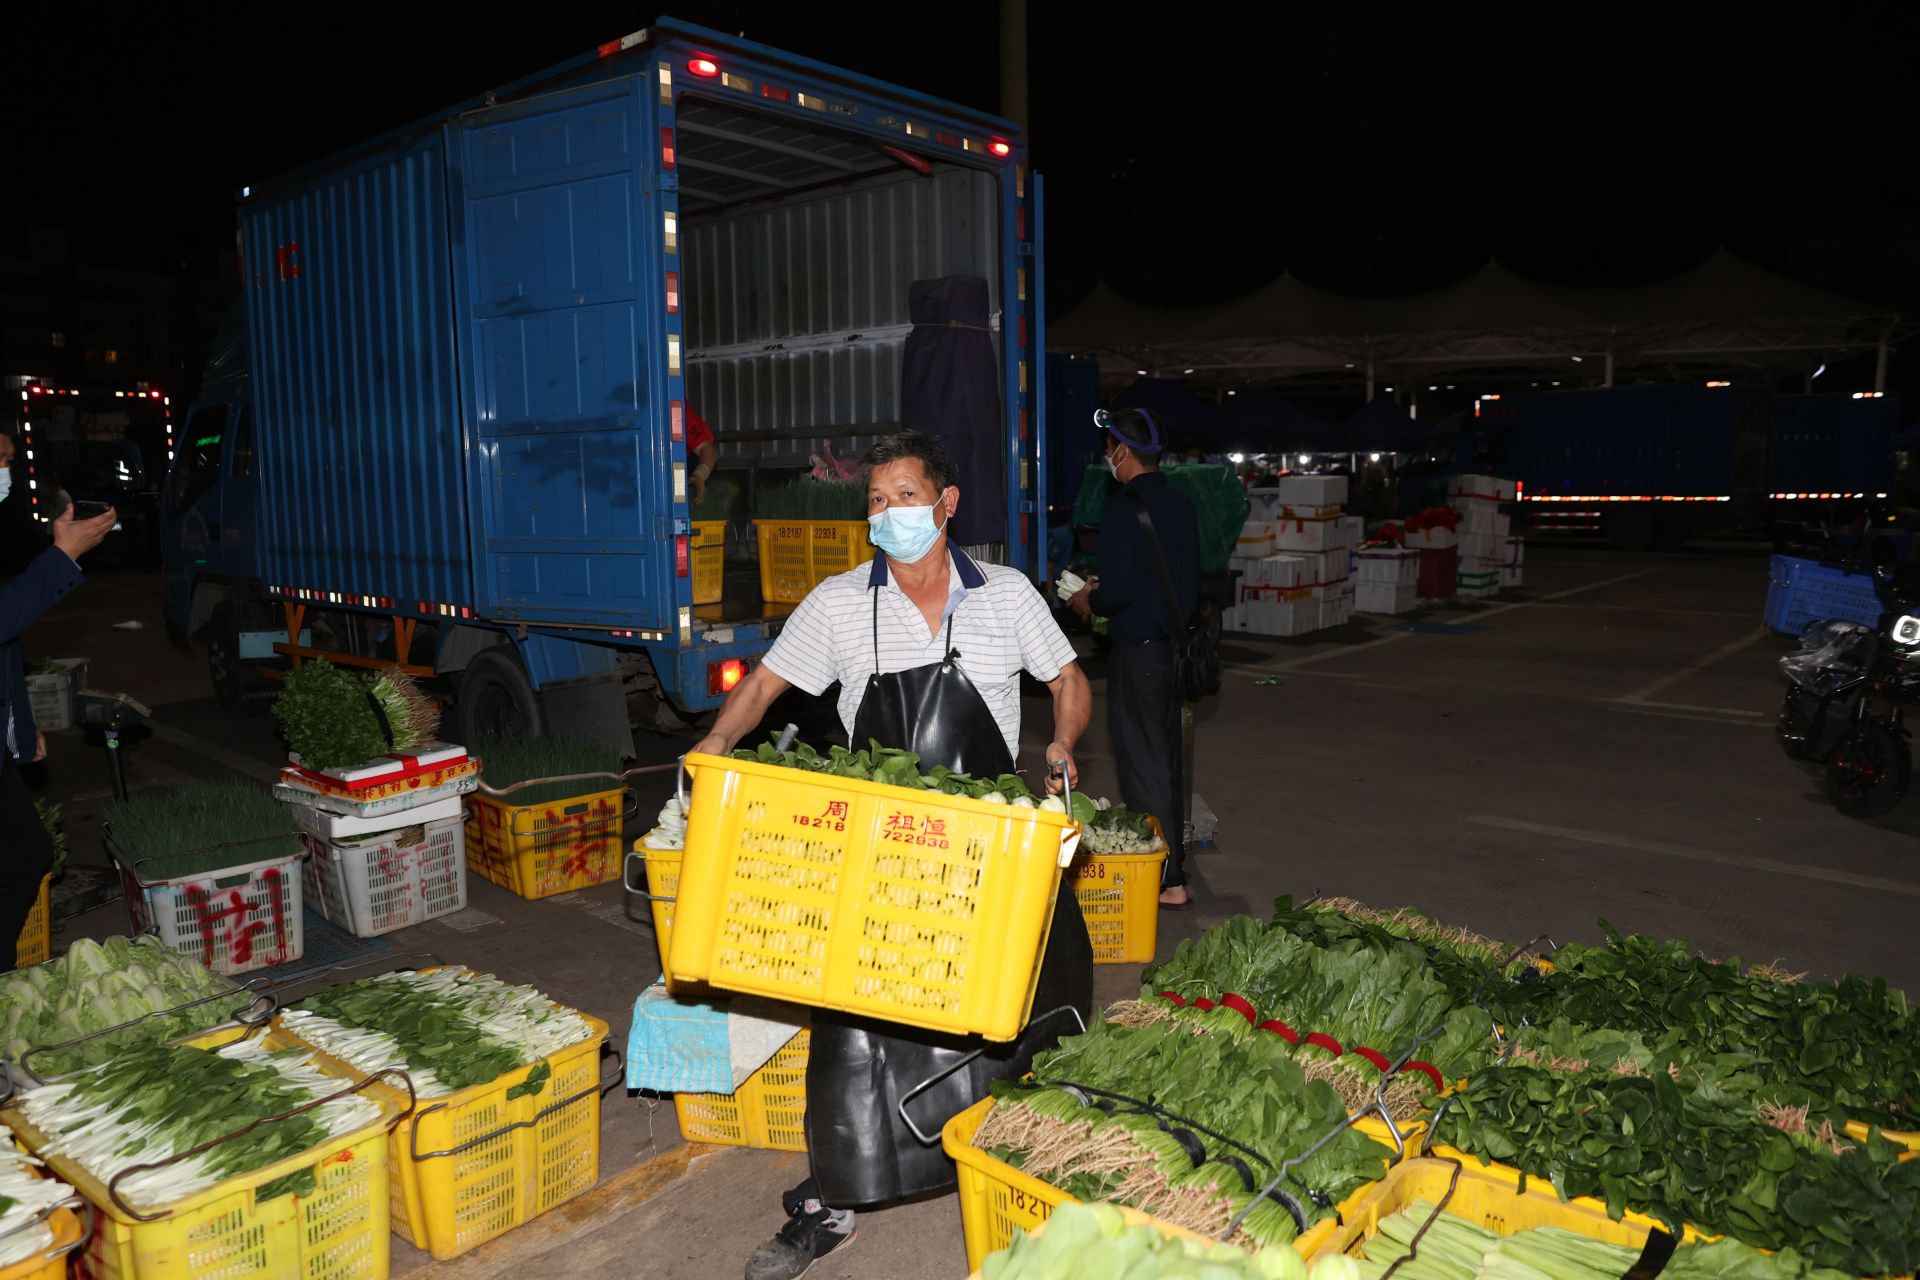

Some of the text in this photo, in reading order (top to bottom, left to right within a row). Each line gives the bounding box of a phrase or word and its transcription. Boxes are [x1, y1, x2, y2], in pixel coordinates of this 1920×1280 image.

[792, 814, 949, 850] 18218 722938
[821, 800, 947, 837] 周 祖恒
